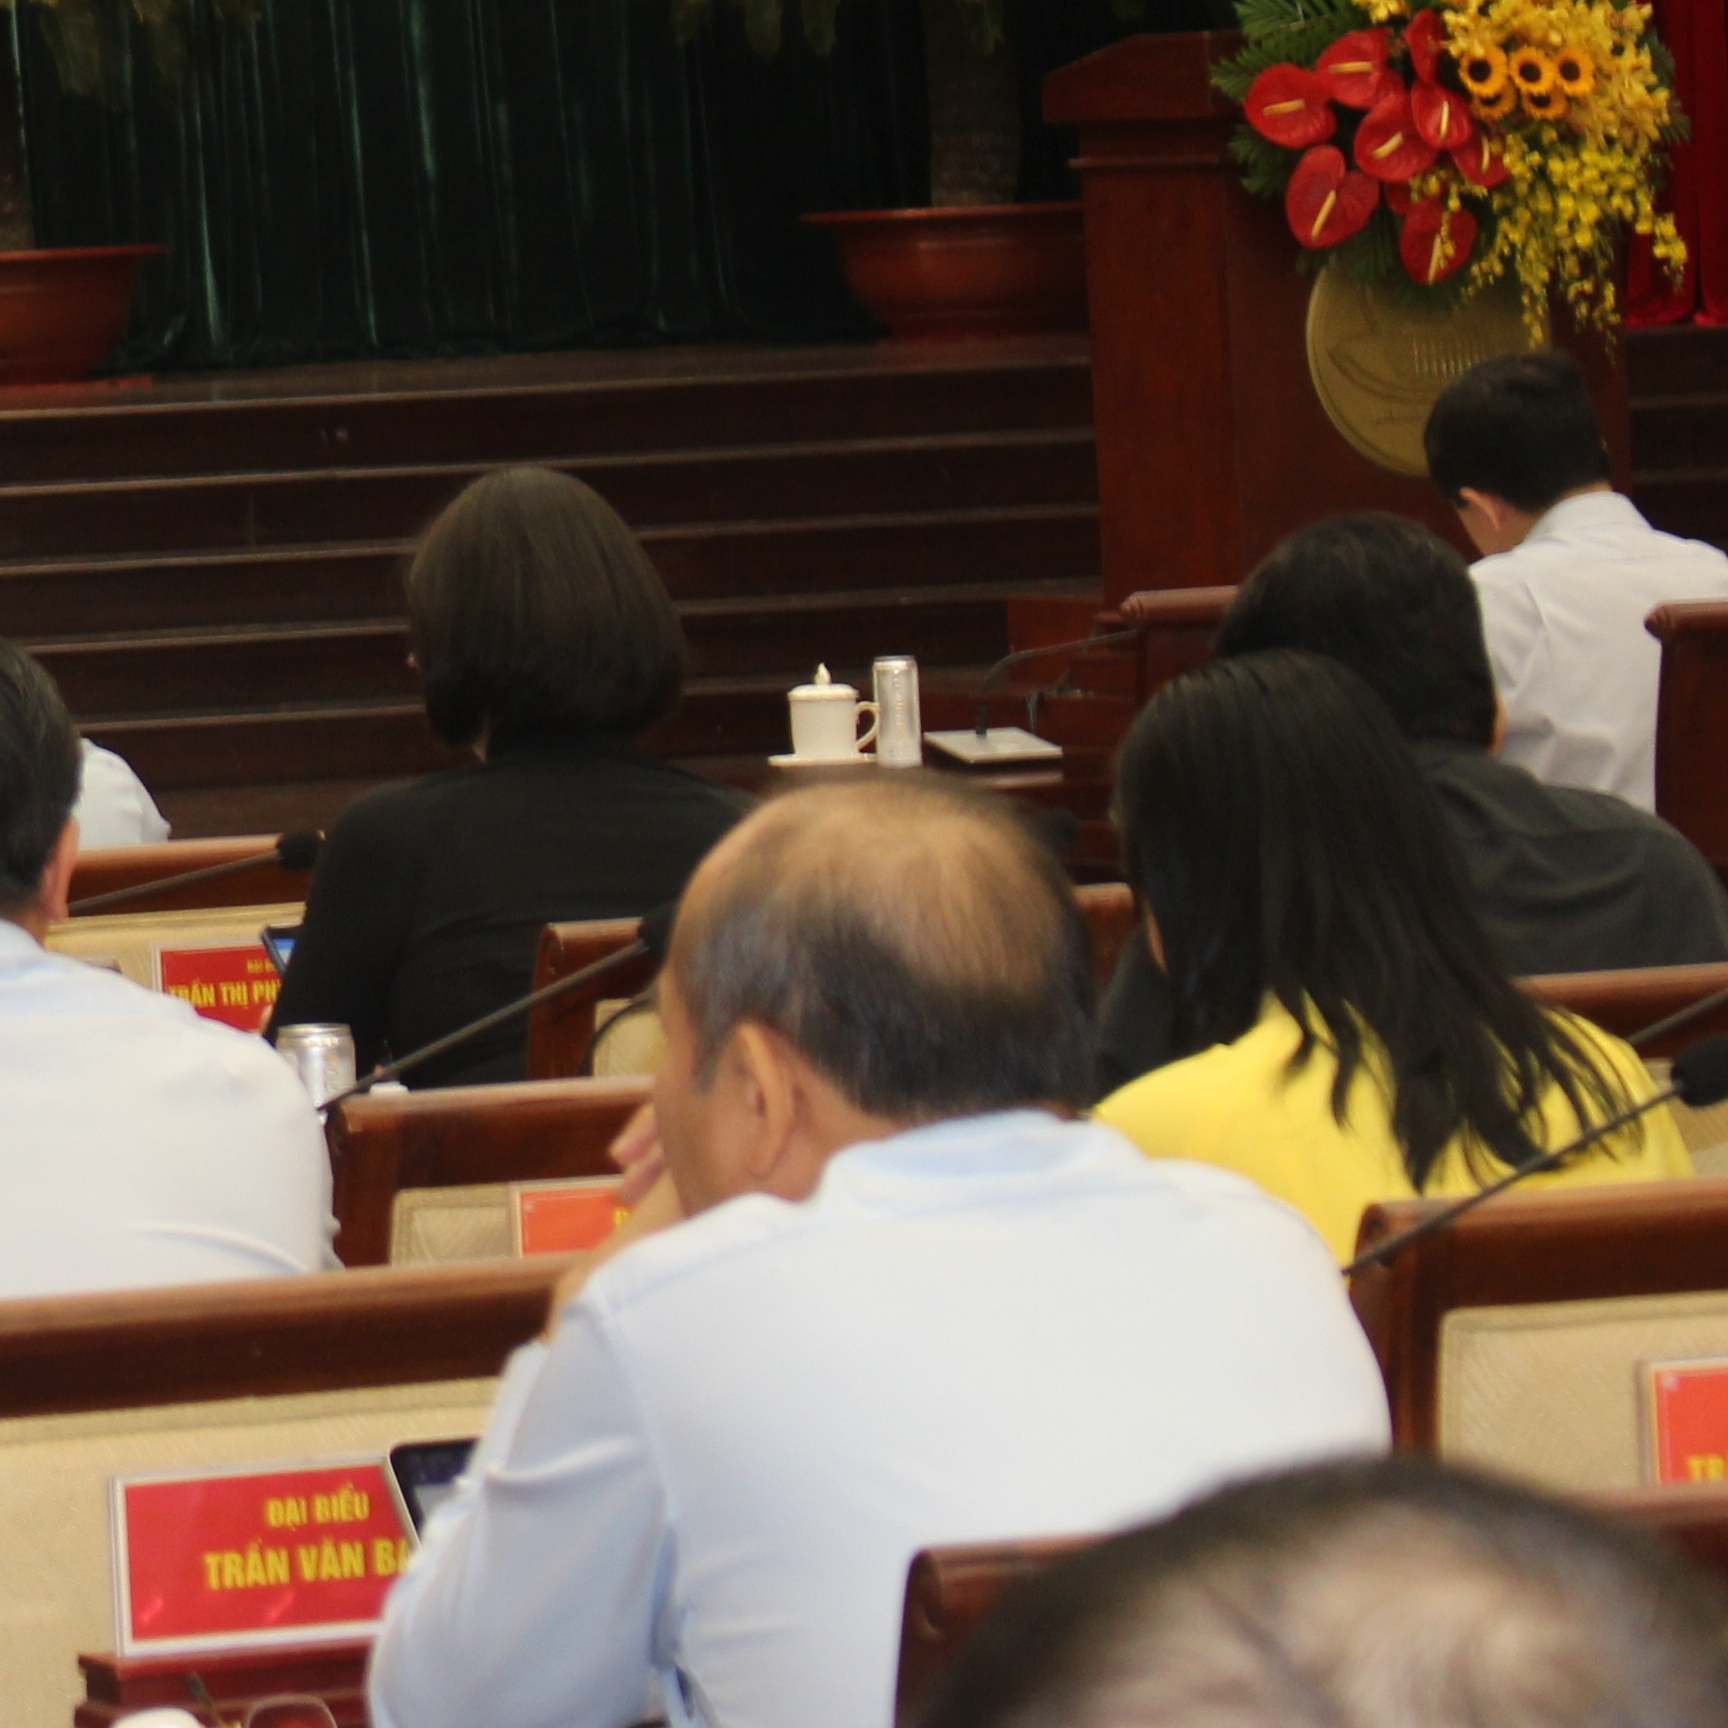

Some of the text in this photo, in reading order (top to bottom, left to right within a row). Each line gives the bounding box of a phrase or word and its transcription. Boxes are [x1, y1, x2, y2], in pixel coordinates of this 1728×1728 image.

[252, 979, 281, 1005] PH
[265, 1481, 371, 1531] ĐẠI BIỂU
[203, 1537, 291, 1590] TRẦN
[297, 1534, 365, 1582] VĂN
